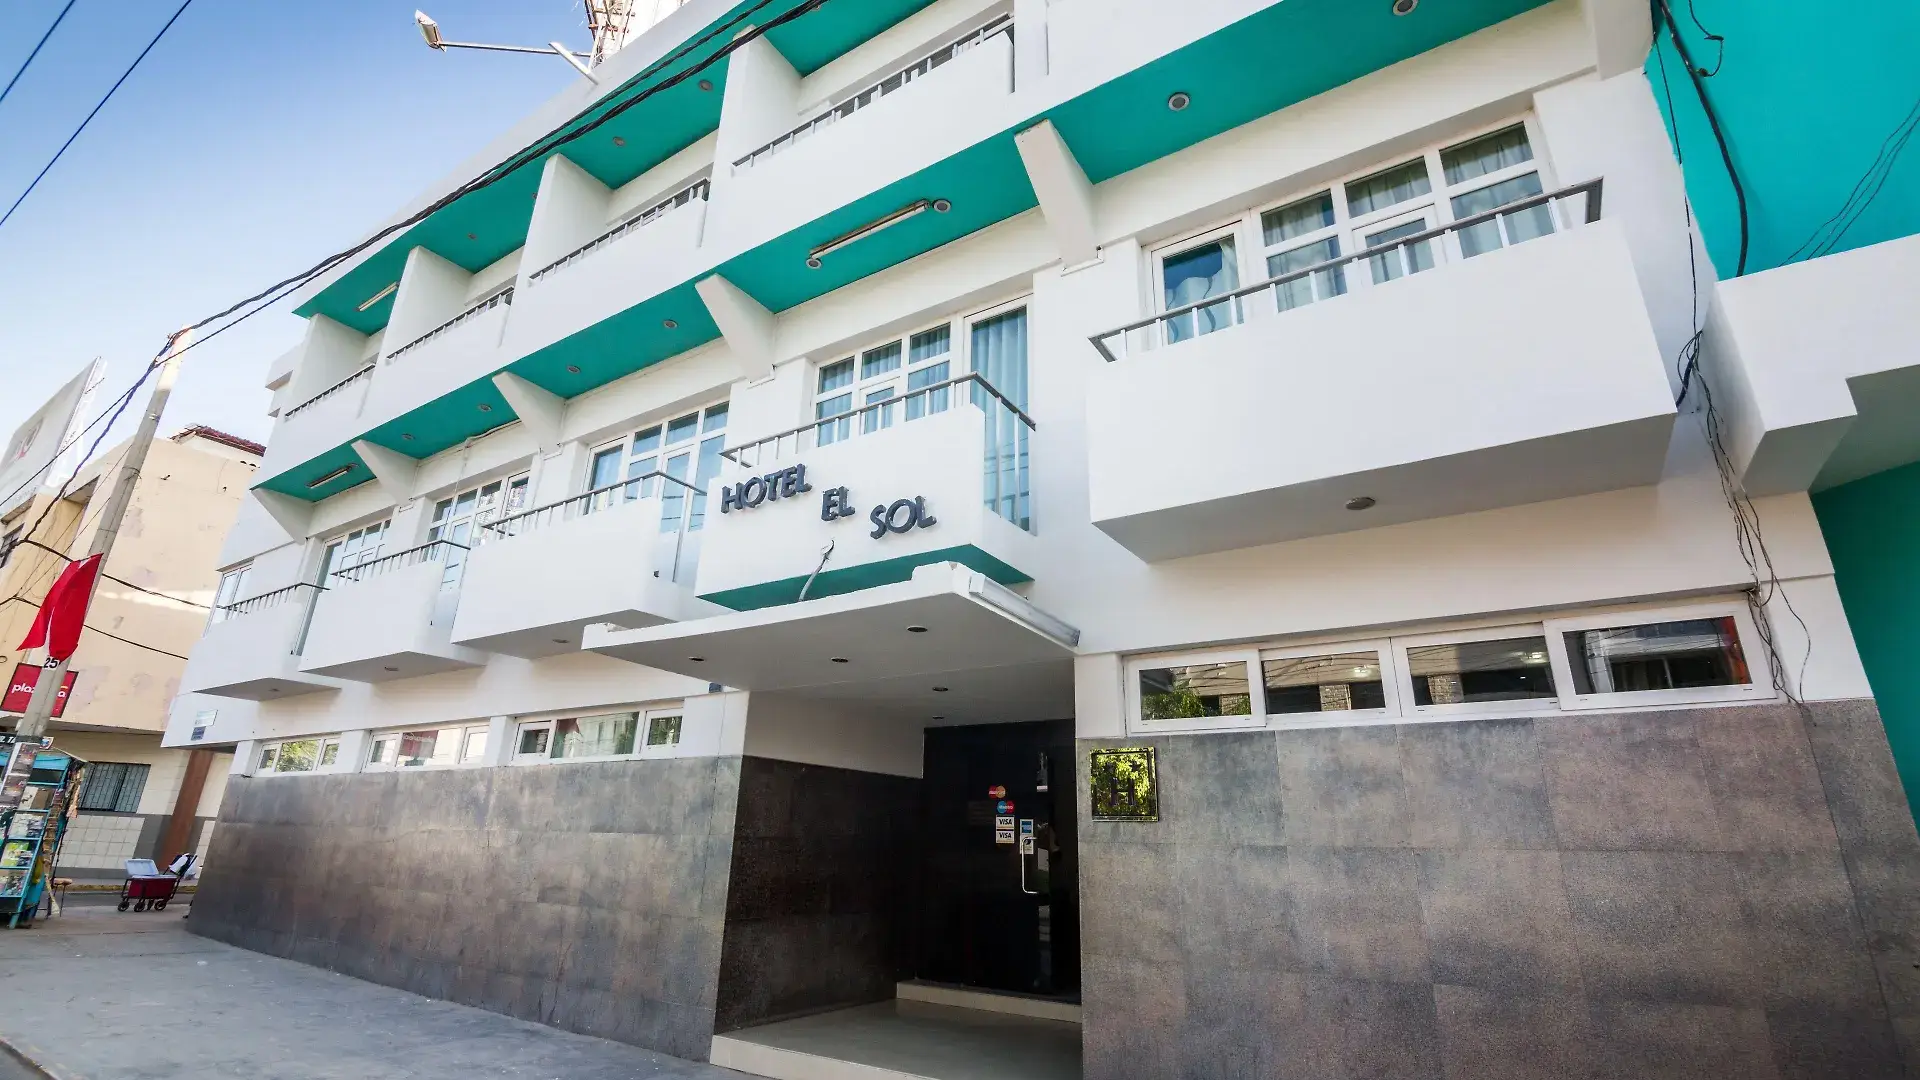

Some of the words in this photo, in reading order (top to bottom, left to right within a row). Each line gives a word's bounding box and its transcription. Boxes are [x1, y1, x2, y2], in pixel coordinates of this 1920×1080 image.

[721, 463, 812, 513] HOTEL
[821, 486, 856, 521] EL
[870, 495, 937, 539] SOL
